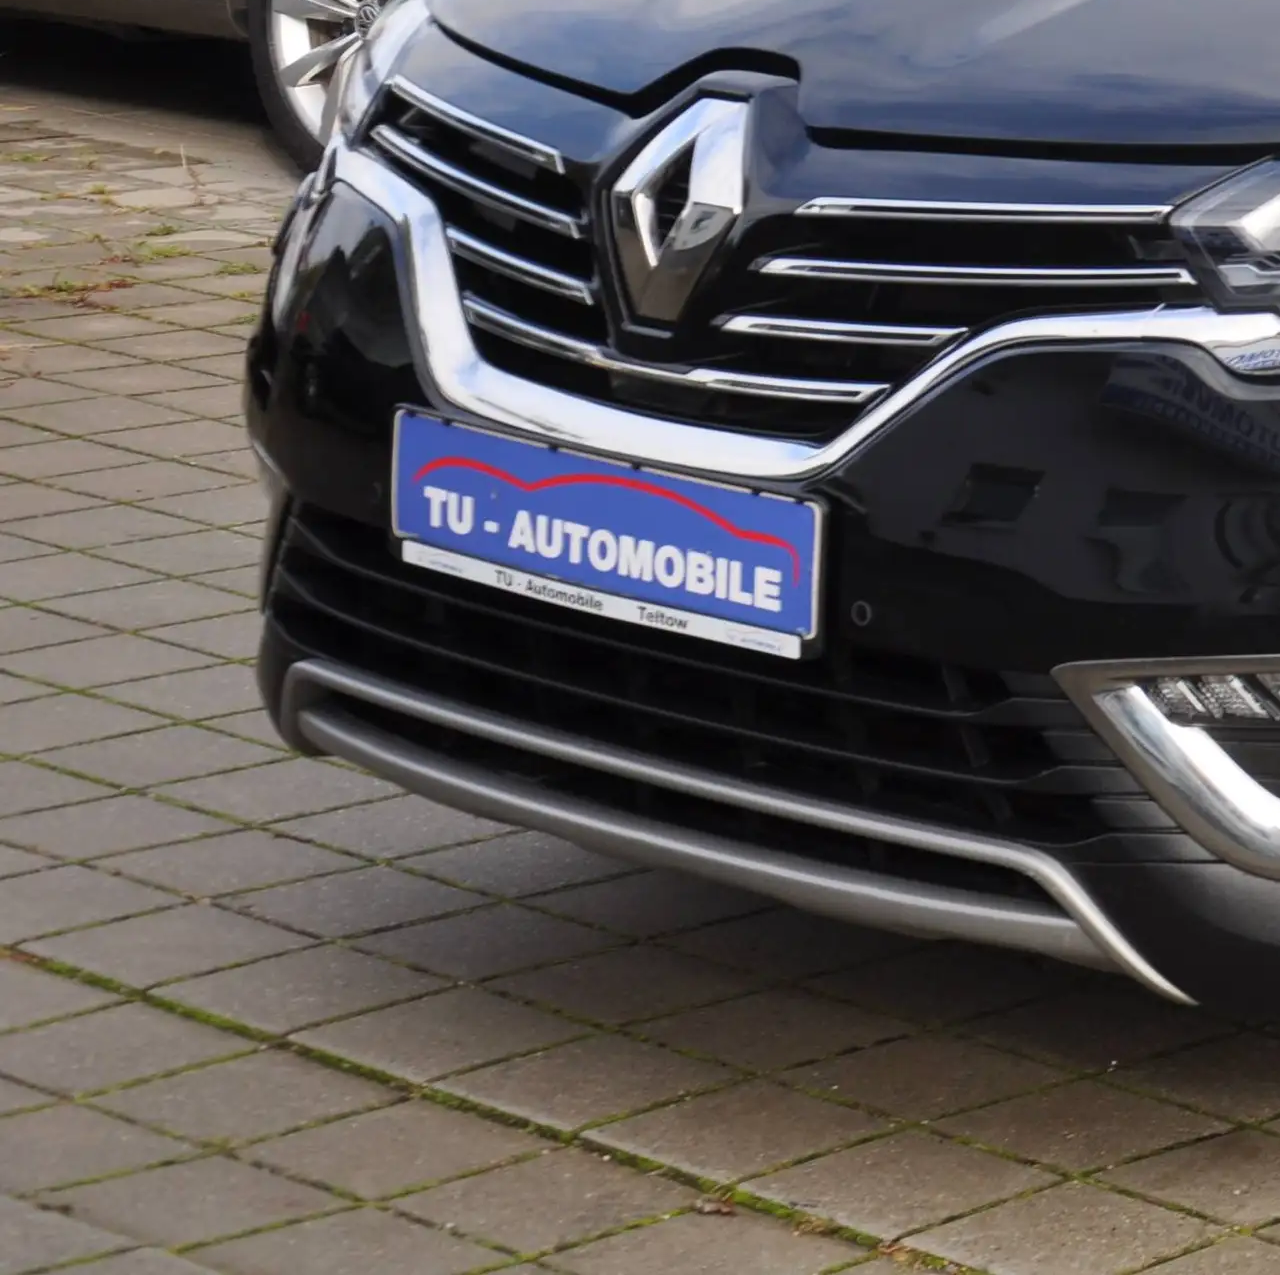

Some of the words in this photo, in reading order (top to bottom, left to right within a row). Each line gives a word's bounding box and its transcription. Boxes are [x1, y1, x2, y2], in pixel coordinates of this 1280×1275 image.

[423, 486, 474, 534] TU
[508, 511, 782, 613] AUTOMOBILE
[494, 569, 513, 588] TU
[525, 579, 604, 611] Automobile
[637, 605, 689, 630] Teltow
